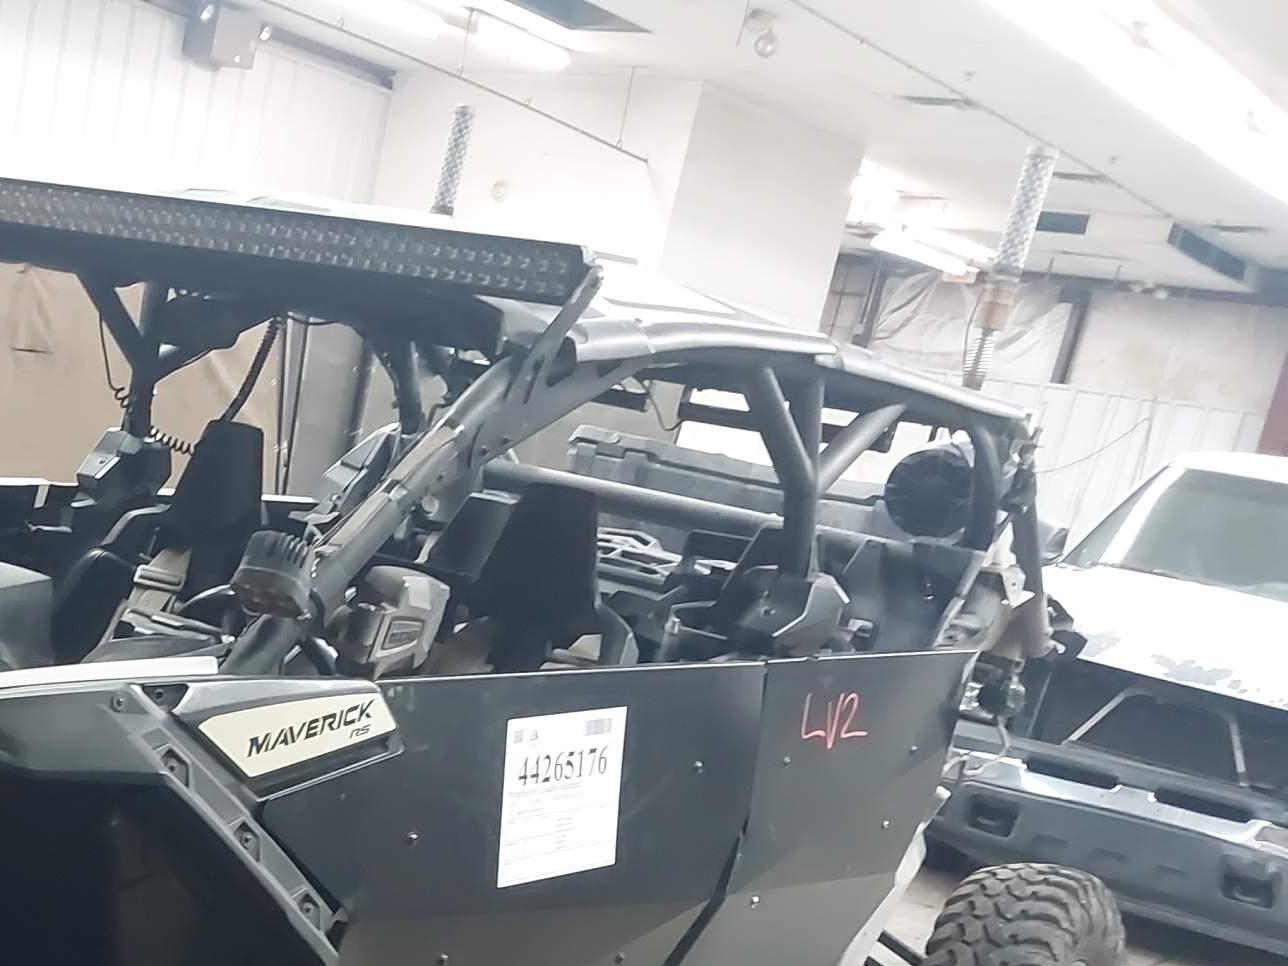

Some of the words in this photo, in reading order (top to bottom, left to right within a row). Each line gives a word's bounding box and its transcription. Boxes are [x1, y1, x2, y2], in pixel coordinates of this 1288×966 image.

[247, 699, 375, 758] MAVERICK
[348, 723, 371, 739] RS
[518, 745, 608, 786] 44265176
